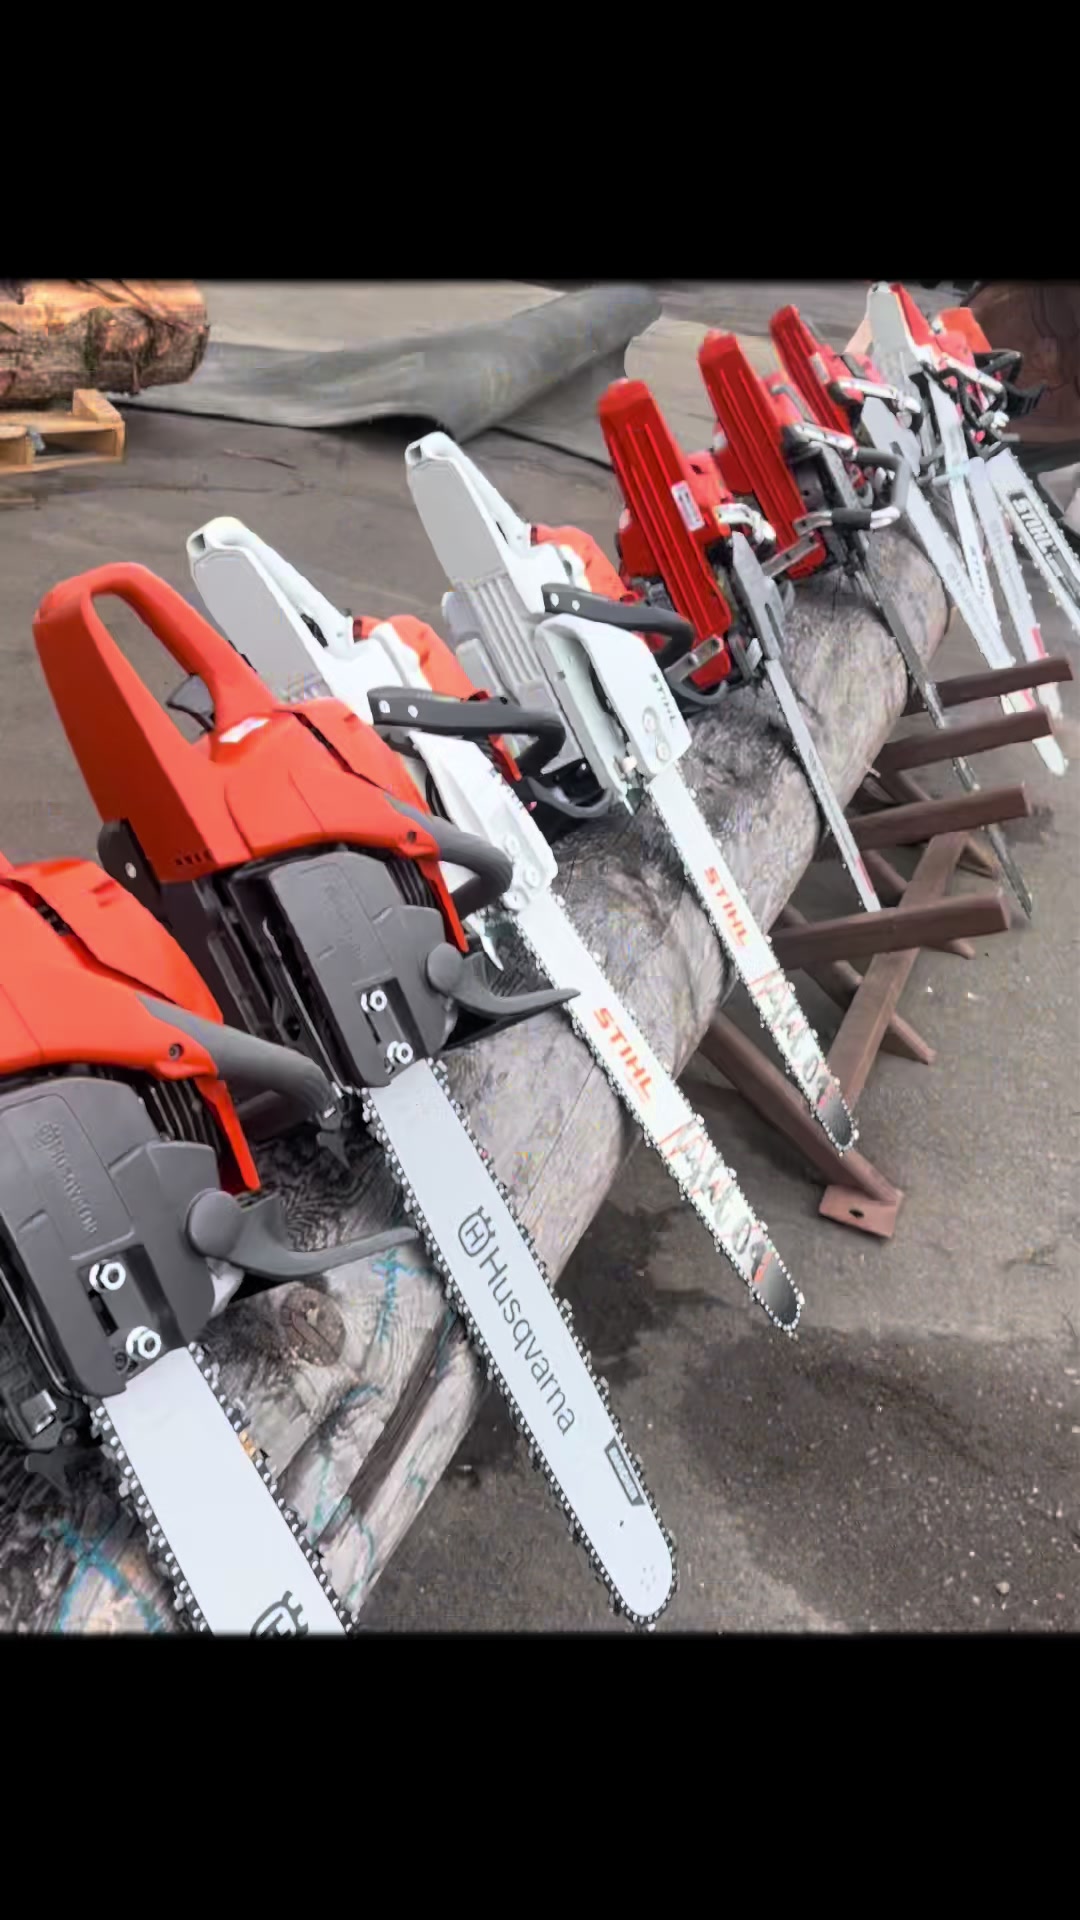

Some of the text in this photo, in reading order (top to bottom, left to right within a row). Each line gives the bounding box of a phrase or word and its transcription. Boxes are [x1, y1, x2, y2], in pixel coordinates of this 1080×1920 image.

[1012, 497, 1055, 555] STIHL
[649, 672, 676, 728] STIHL
[704, 866, 747, 946] STIHL
[593, 1007, 651, 1102] STIHL
[479, 1246, 575, 1436] Husqvarna
